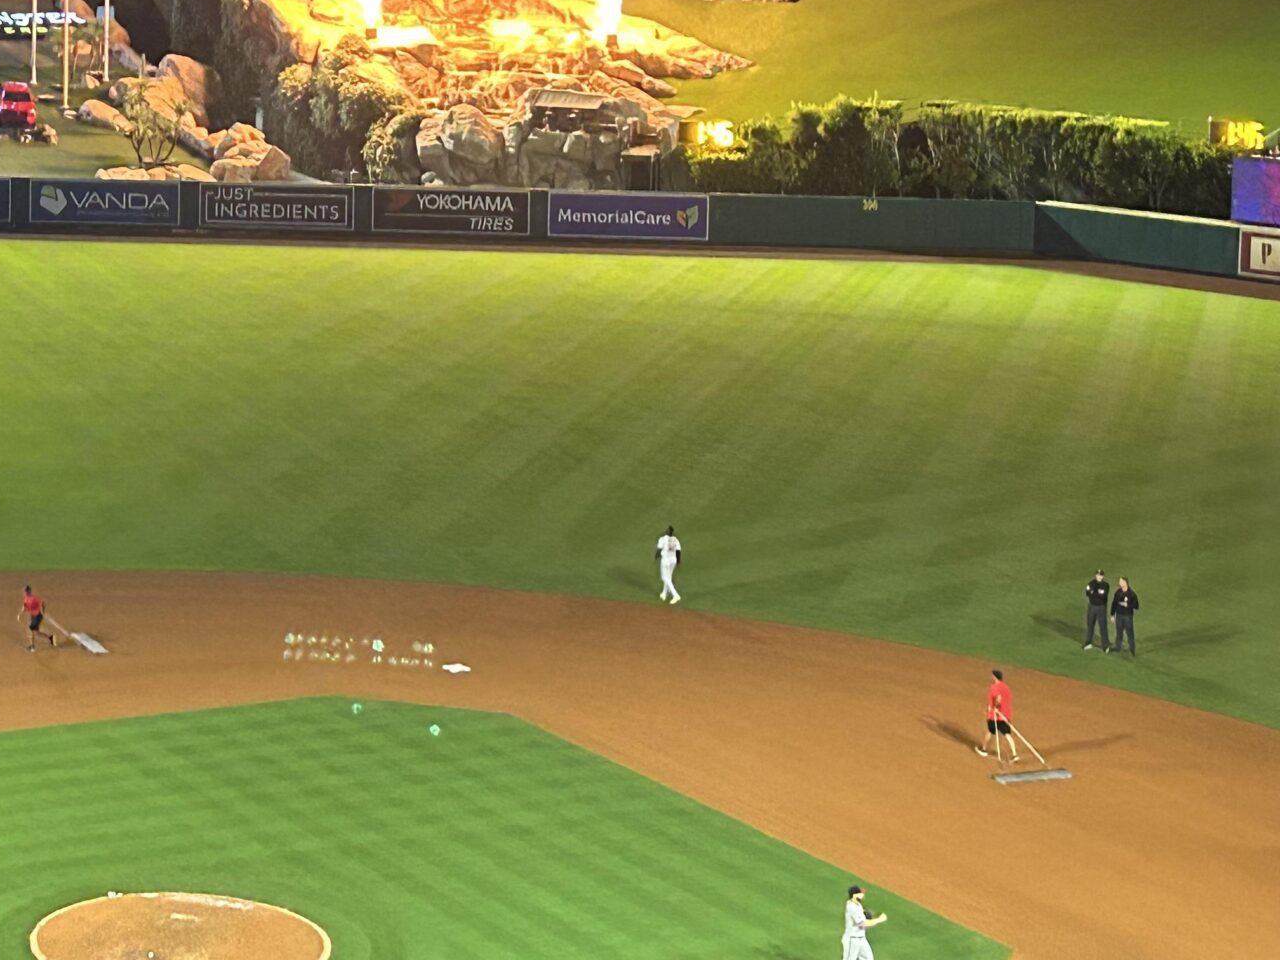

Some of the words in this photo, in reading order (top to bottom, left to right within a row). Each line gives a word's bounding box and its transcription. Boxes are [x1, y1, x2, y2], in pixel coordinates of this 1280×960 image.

[70, 191, 169, 209] VANDA
[214, 187, 253, 201] JUST
[417, 193, 514, 211] YOKOHAMA
[214, 202, 339, 220] INGREDIENTS
[558, 208, 671, 225] MemorialCare
[470, 217, 514, 231] TIRES
